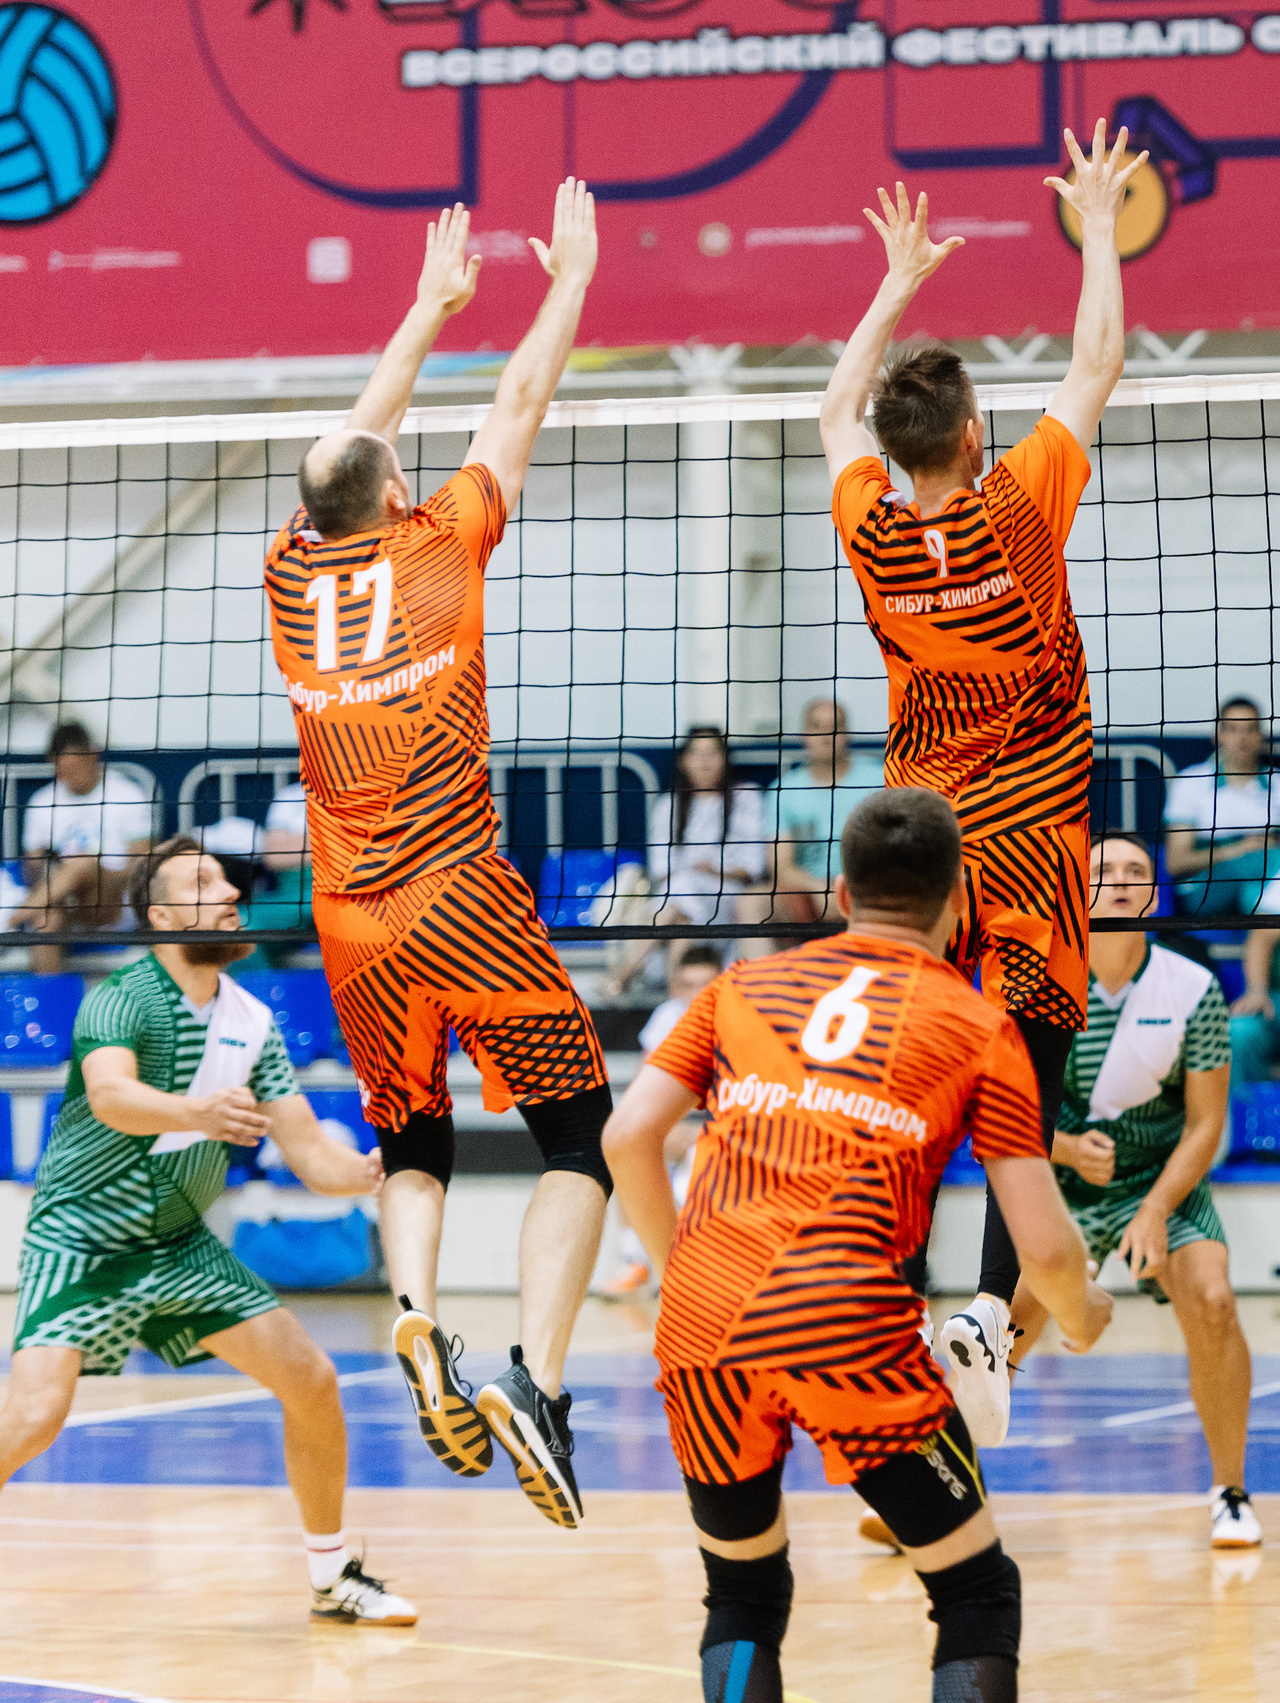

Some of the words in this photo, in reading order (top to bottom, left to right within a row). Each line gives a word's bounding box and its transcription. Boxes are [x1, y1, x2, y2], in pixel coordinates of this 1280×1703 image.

[402, 23, 885, 87] ВСЕРОССИЙСКИЙ
[893, 17, 1244, 67] ФЕСТИВАЛЬ
[924, 529, 948, 579] 9
[305, 557, 393, 671] 17
[885, 571, 1014, 614] СИБУР-ХИМПРОМ
[801, 965, 883, 1062] 6
